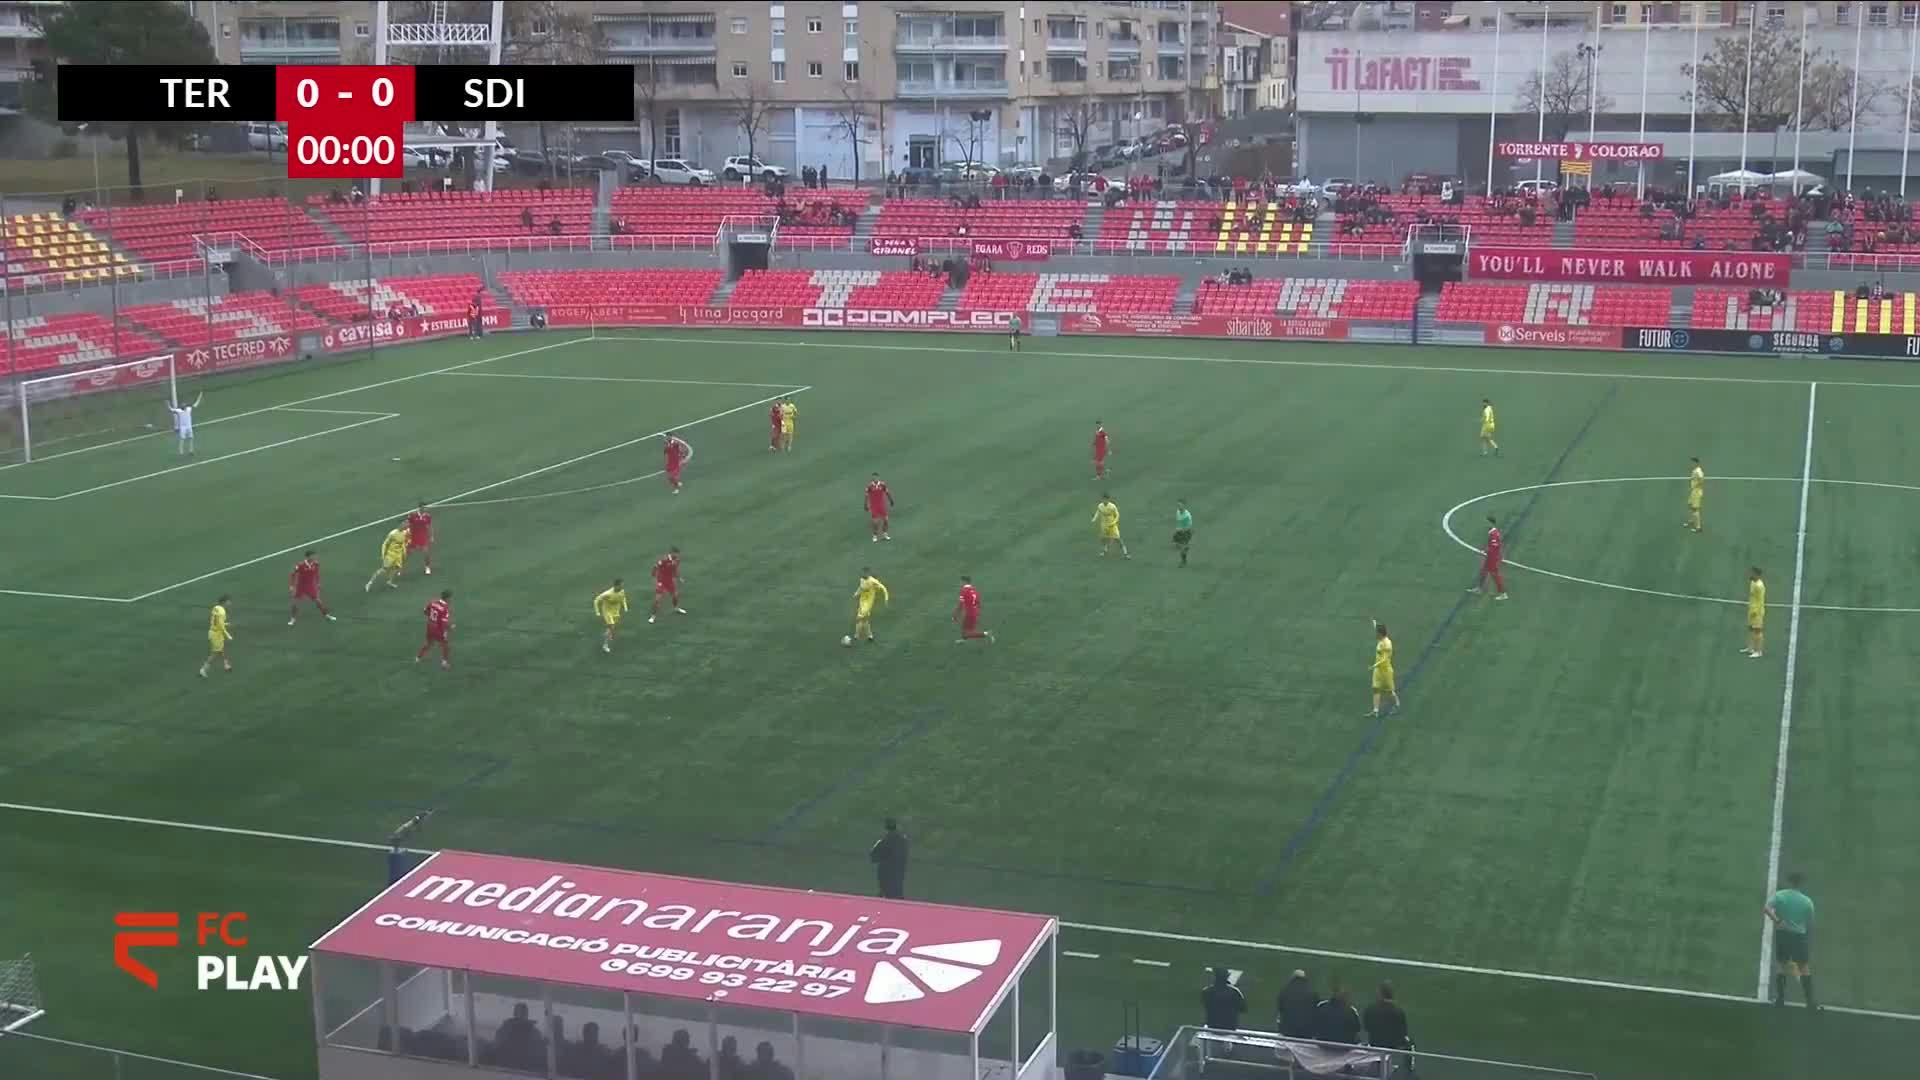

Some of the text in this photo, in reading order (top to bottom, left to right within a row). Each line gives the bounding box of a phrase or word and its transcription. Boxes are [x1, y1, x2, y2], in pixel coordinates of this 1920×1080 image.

[1355, 57, 1431, 90] LaFACT
[1499, 143, 1660, 158] TORRENTE COLORAO
[975, 244, 1048, 254] EGARA REDS
[1479, 254, 1776, 279] YOU'LL NEVER WALK ALONE
[430, 319, 468, 331] ESTRELLA
[213, 340, 266, 360] TECFRED
[1773, 333, 1820, 347] SEGUNDA
[404, 874, 910, 957] medianaranja
[374, 913, 857, 984] COMUNICACIÓ PUBLICITÀRIA
[626, 961, 853, 999] 699 93 22 97
